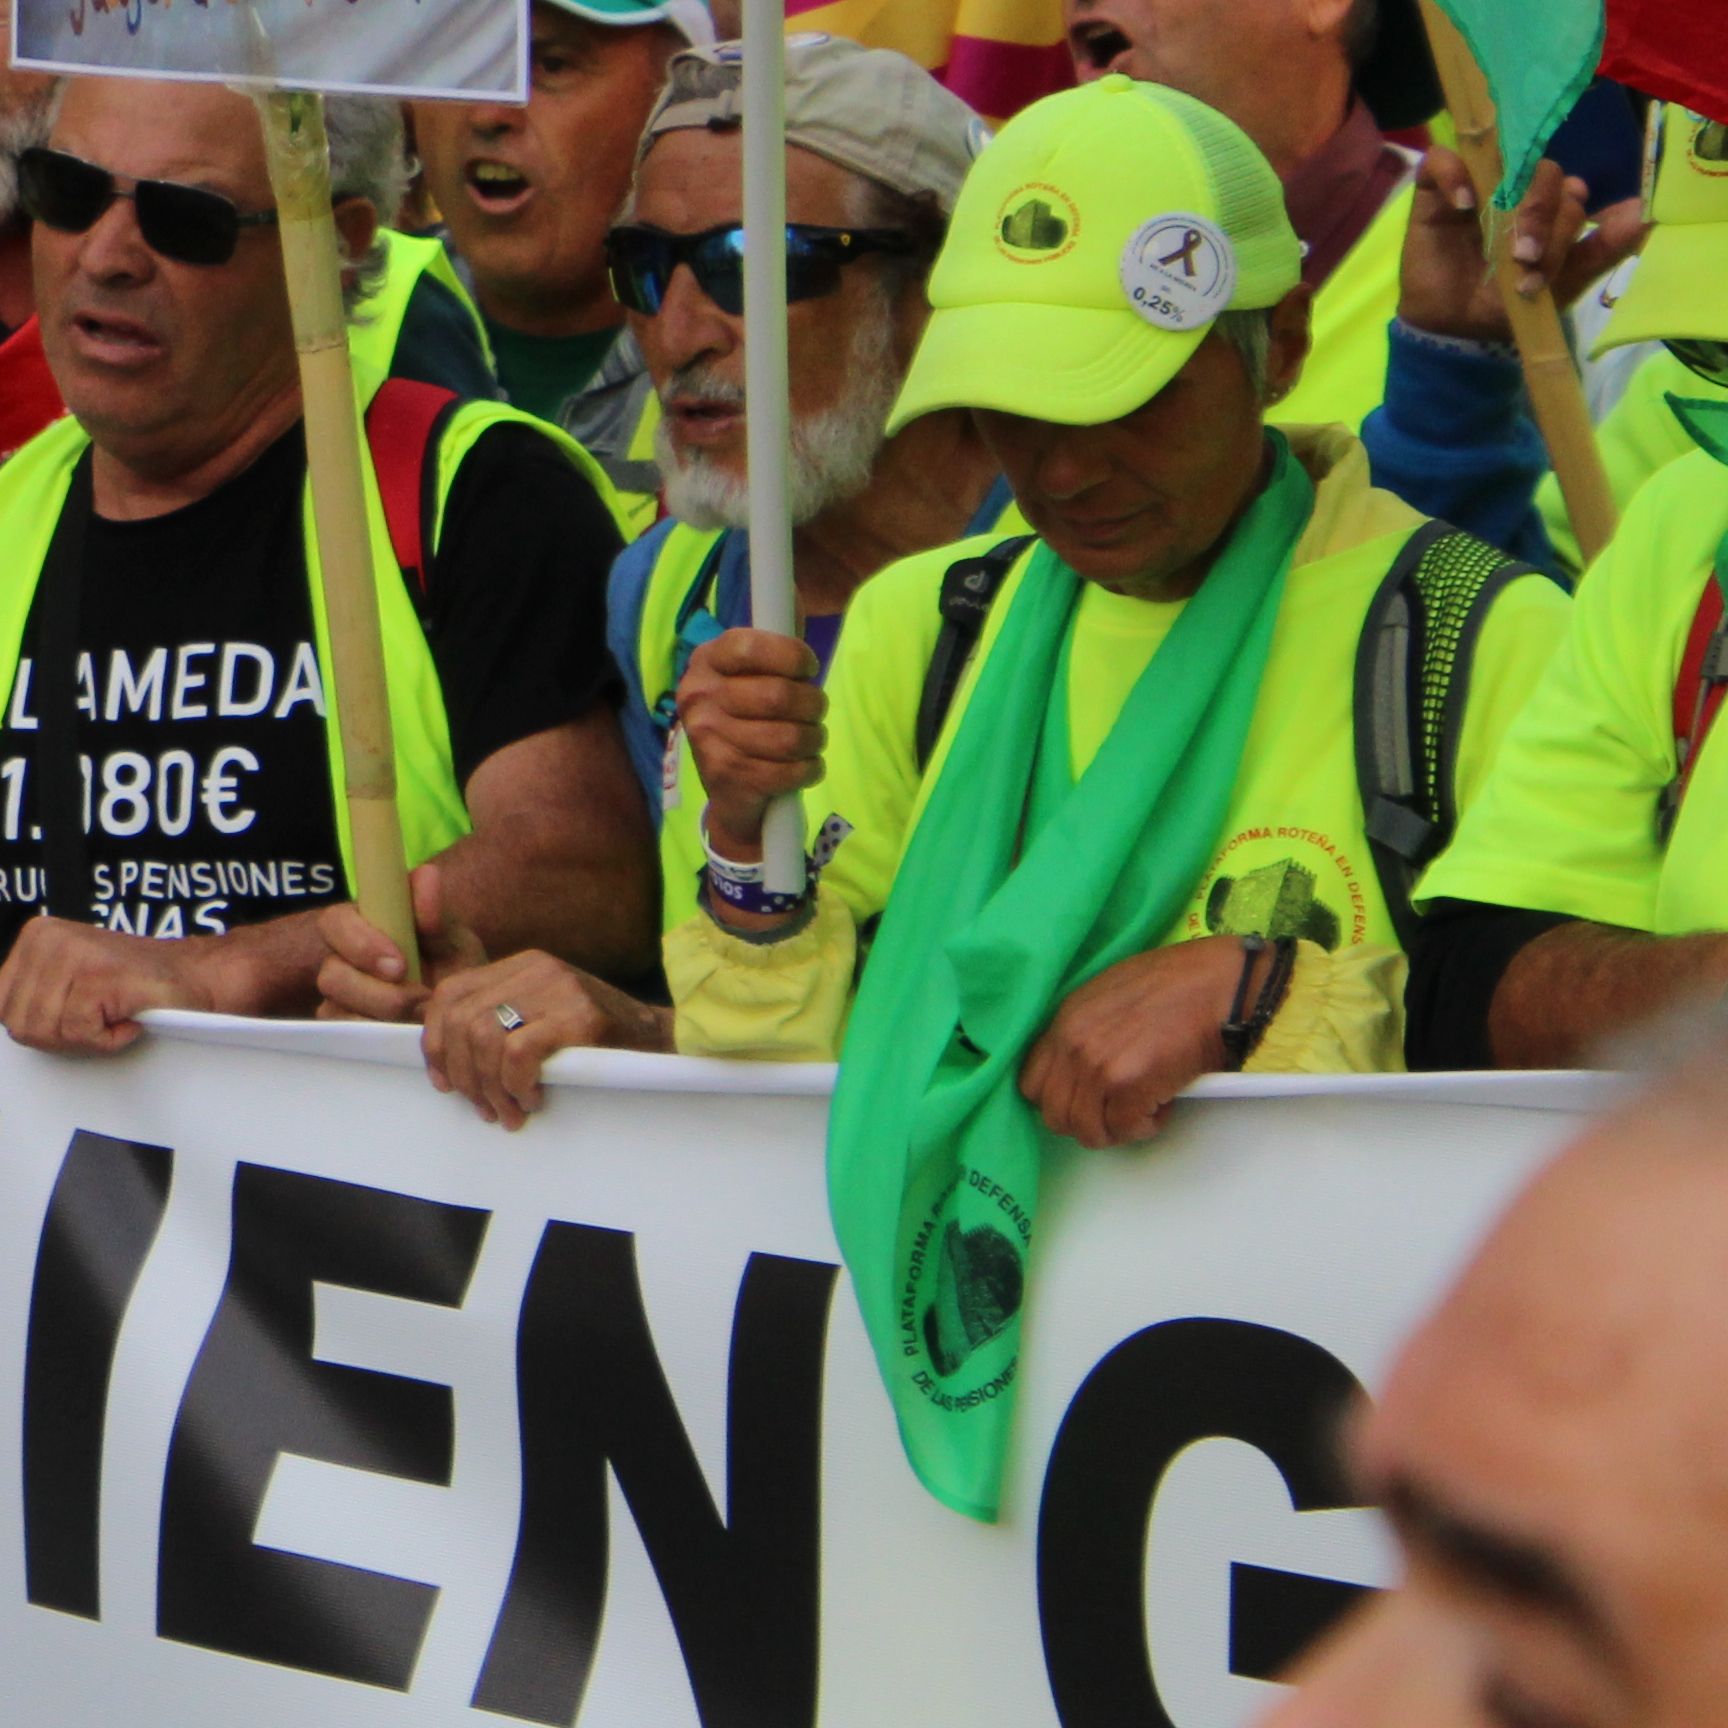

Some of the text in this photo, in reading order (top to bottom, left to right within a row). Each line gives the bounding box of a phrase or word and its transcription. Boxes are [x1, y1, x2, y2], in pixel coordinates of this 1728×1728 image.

[1133, 286, 1185, 323] 0,25%
[8, 642, 328, 730] LAMEDA
[0, 745, 260, 841] 1.80€
[119, 860, 335, 901] PENSIONES
[1277, 826, 1337, 856] ROTEÑA
[1334, 854, 1354, 878] EN
[1346, 880, 1366, 946] DEFENS
